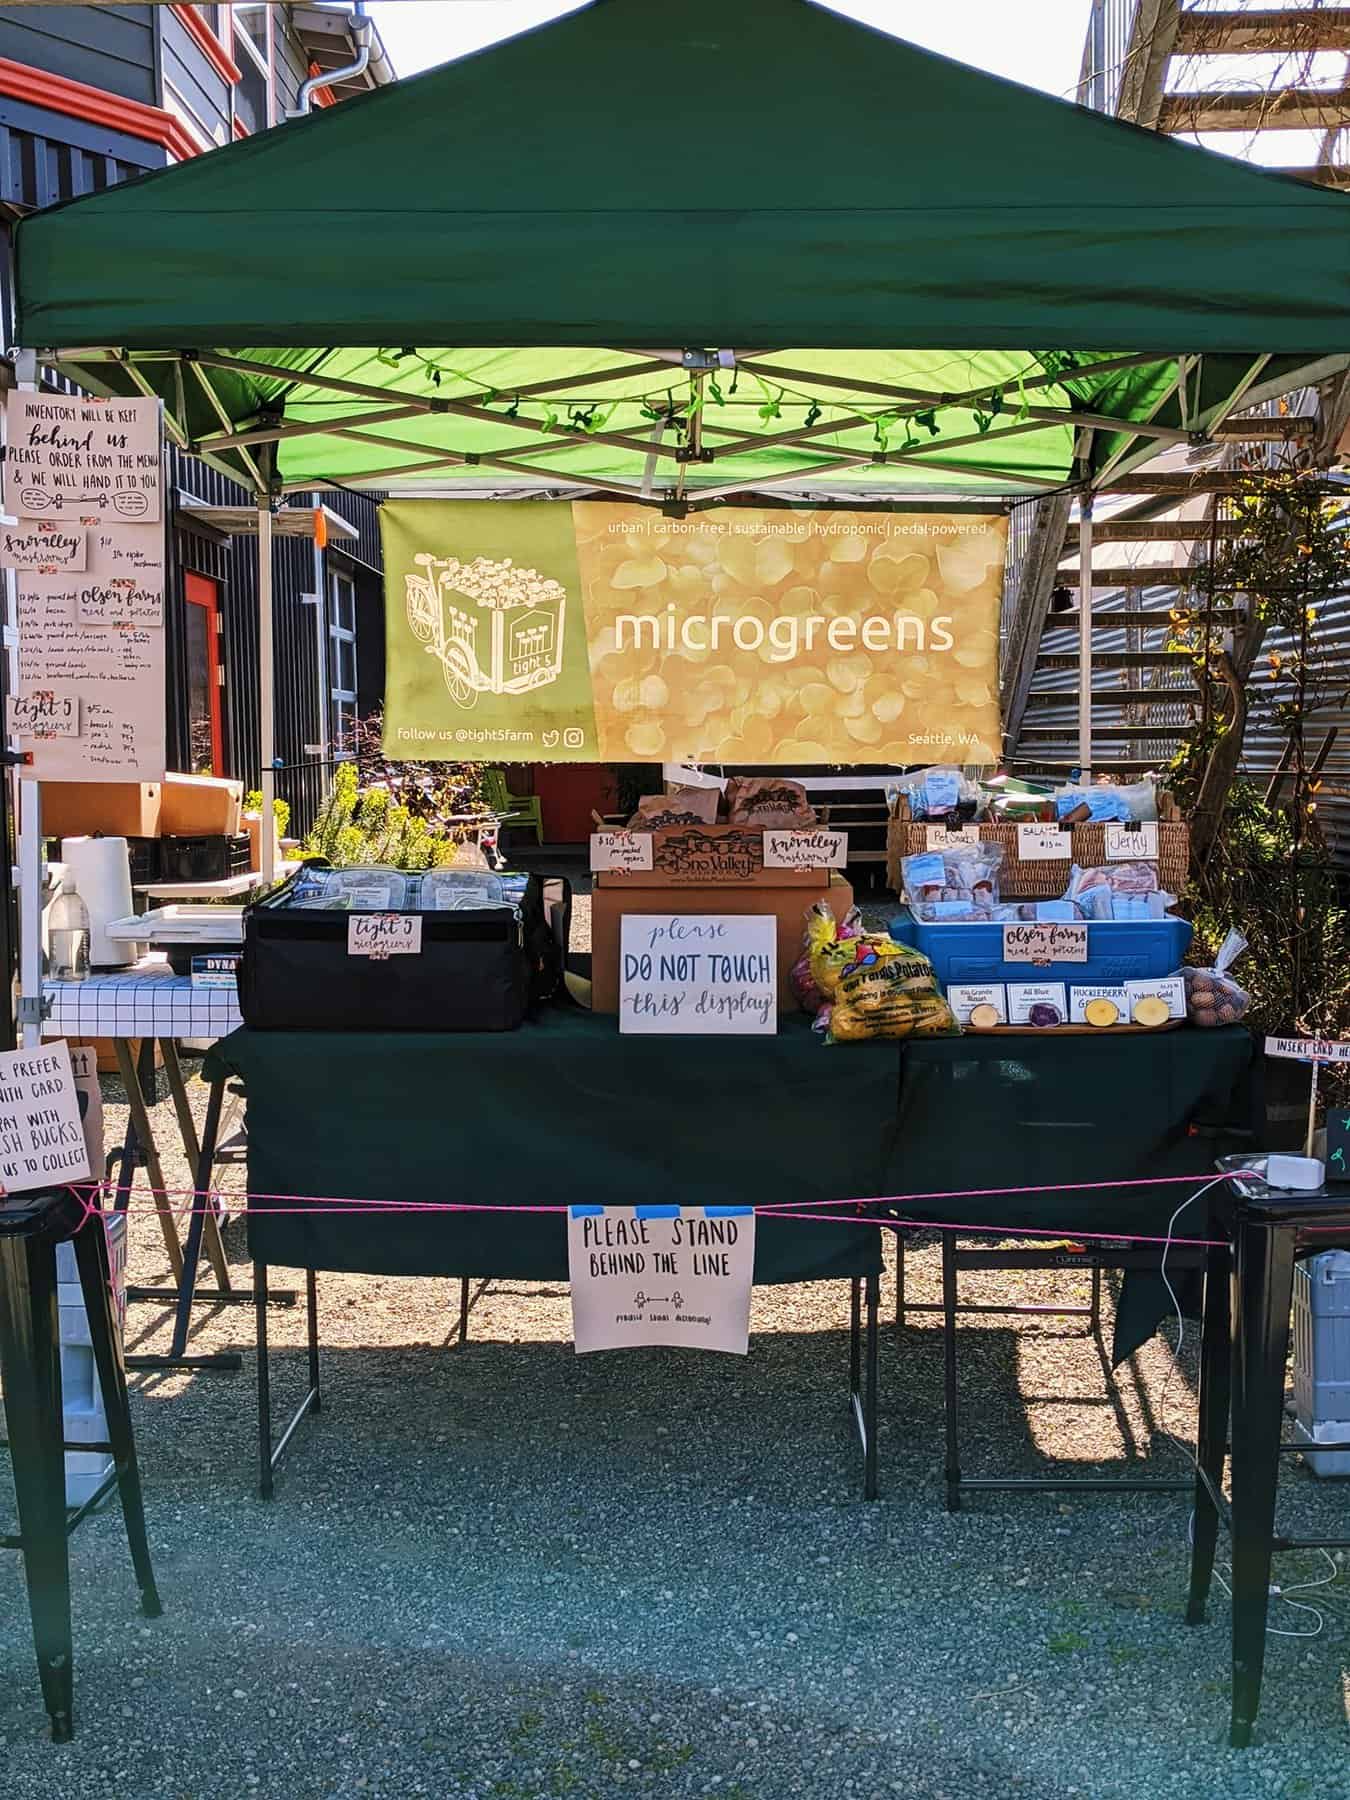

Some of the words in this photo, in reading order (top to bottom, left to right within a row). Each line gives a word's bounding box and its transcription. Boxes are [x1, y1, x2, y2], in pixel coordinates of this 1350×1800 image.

[25, 404, 76, 421] INVENTORY
[81, 409, 102, 422] WILL
[105, 409, 115, 423] BE
[119, 409, 137, 423] KEPT
[26, 424, 93, 451] behind
[8, 447, 42, 465] PLEASE
[49, 453, 82, 467] ORDER
[87, 453, 113, 469] FROM
[118, 454, 134, 469] THE
[136, 454, 158, 469] MENU
[13, 469, 23, 485] &
[31, 471, 47, 486] WE
[53, 472, 77, 488] WILL
[83, 474, 111, 489] HAND
[115, 475, 124, 489] IT
[127, 475, 137, 489] TO
[140, 474, 157, 488] YOU
[608, 521, 643, 533] urban
[654, 521, 724, 533] carbon-free
[735, 521, 805, 535] sustainable
[814, 522, 884, 537] hydroponic
[893, 523, 987, 537] pedal-powered
[615, 603, 954, 663] microgreens
[513, 657, 542, 676] tight
[545, 655, 552, 666] 5
[9, 694, 62, 722] tight
[64, 698, 72, 716] 5
[398, 728, 436, 740] Follow
[439, 731, 453, 740] us
[455, 729, 534, 743] @tight5farm
[908, 732, 955, 746] Seattle,
[958, 733, 980, 744] WA
[598, 835, 615, 846] $10
[711, 855, 752, 878] Valley
[352, 917, 401, 941] tight
[404, 918, 412, 935] 5
[648, 918, 728, 948] please
[625, 954, 651, 982] DO
[660, 954, 700, 982] NOT
[708, 954, 771, 983] TOUCH
[1073, 988, 1128, 998] HUCKLEBERRY
[1156, 990, 1174, 998] Gold
[623, 991, 686, 1016] this
[695, 990, 773, 1024] display
[1277, 1039, 1307, 1054] INSERT
[1313, 1041, 1334, 1056] CARD
[13, 1056, 61, 1078] PREFER
[27, 1109, 60, 1127] WITH
[0, 1132, 24, 1156] SH
[24, 1157, 38, 1173] TO
[42, 1148, 87, 1172] COLLECT
[583, 1217, 650, 1248] PLEASE
[671, 1217, 738, 1246] STAND
[590, 1253, 646, 1278] BEHIND
[652, 1252, 680, 1275] THE
[694, 1253, 731, 1277] LINE
